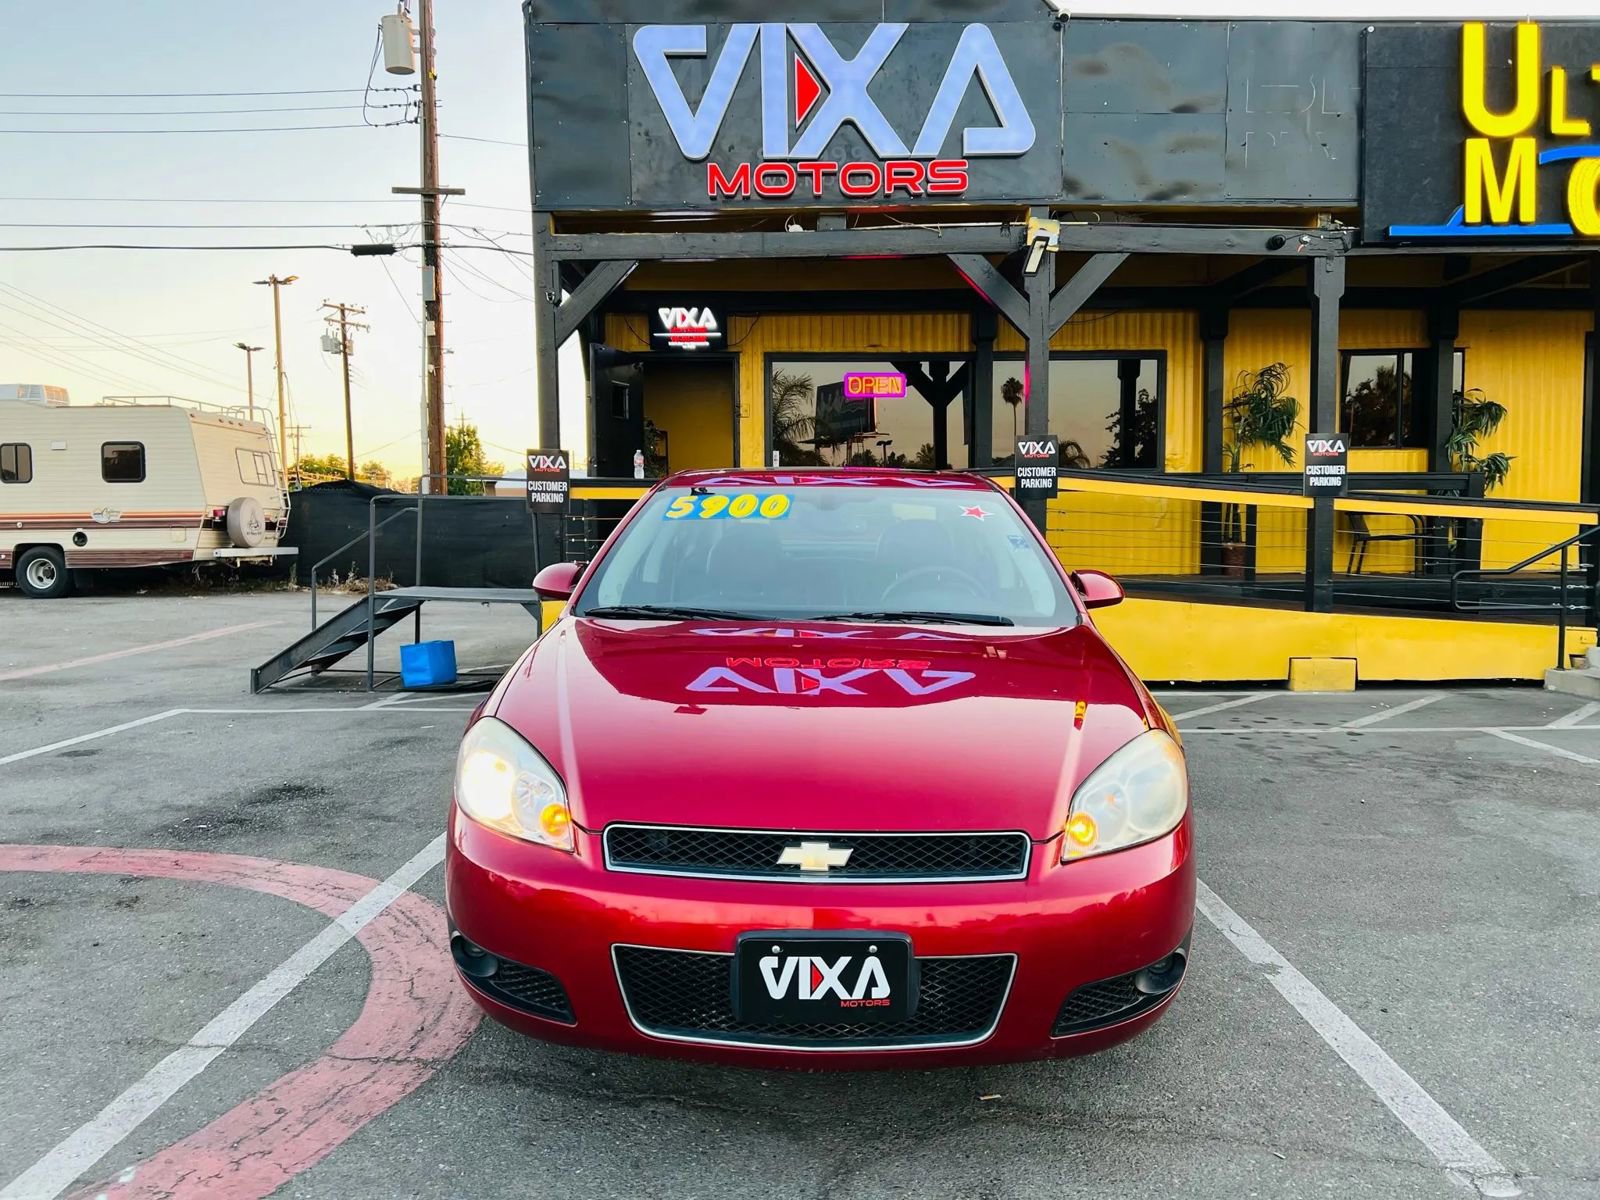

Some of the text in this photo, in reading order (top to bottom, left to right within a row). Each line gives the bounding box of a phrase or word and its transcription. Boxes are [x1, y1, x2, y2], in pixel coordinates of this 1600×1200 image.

[633, 22, 1037, 160] VIXA
[707, 159, 969, 197] MOTORS
[657, 306, 718, 330] VIXA
[847, 376, 902, 394] OPEN
[1017, 441, 1056, 455] VIXA
[1306, 439, 1346, 453] VIXA
[528, 455, 567, 469] VIXA
[1017, 466, 1057, 477] CUSTOMER
[1306, 465, 1346, 475] CUSTOMER
[528, 480, 568, 492] CUSTOMER
[1020, 478, 1053, 489] PARKING
[1309, 476, 1342, 487] PARKING
[531, 492, 564, 503] PARKING
[665, 493, 791, 519] 5900
[758, 955, 891, 1000] VIXA
[840, 999, 891, 1008] MOTORS
